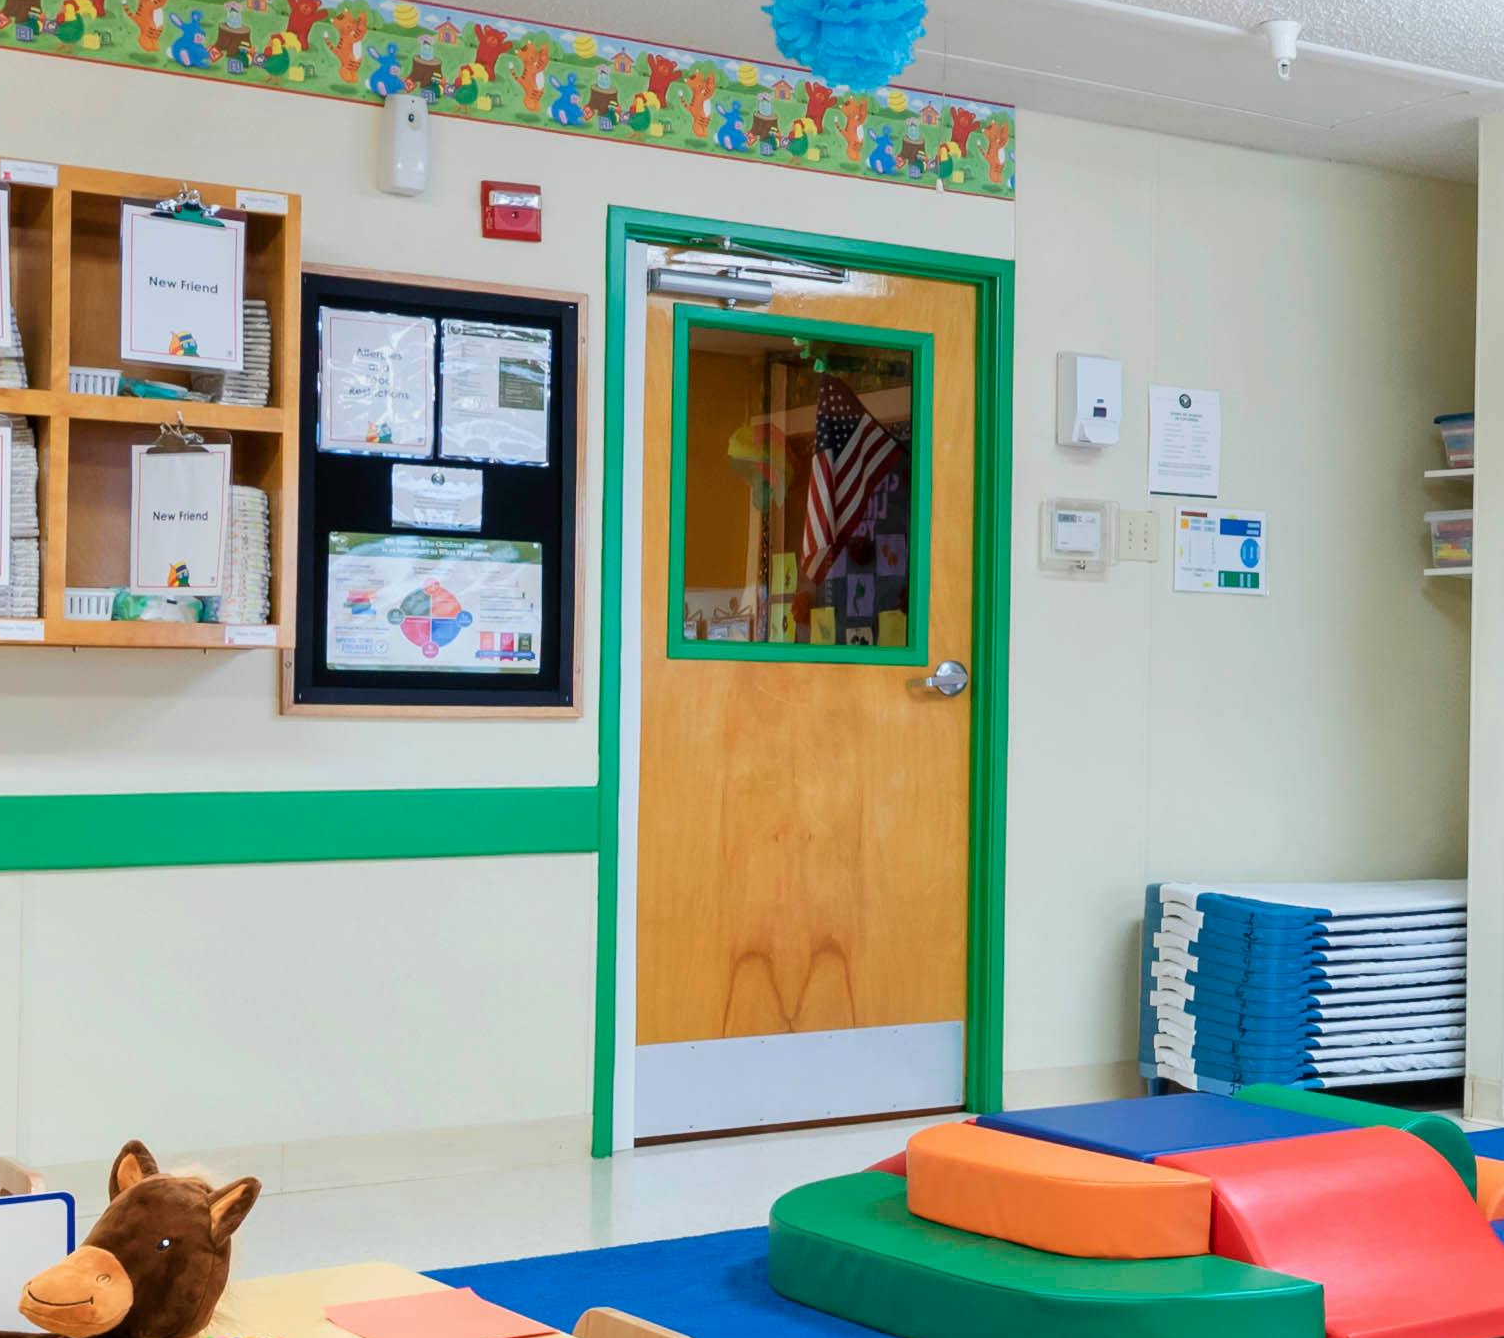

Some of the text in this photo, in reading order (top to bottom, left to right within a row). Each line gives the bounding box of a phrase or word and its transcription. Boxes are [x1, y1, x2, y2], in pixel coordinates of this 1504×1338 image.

[150, 277, 217, 293] New Friend
[153, 511, 208, 520] New Friend
